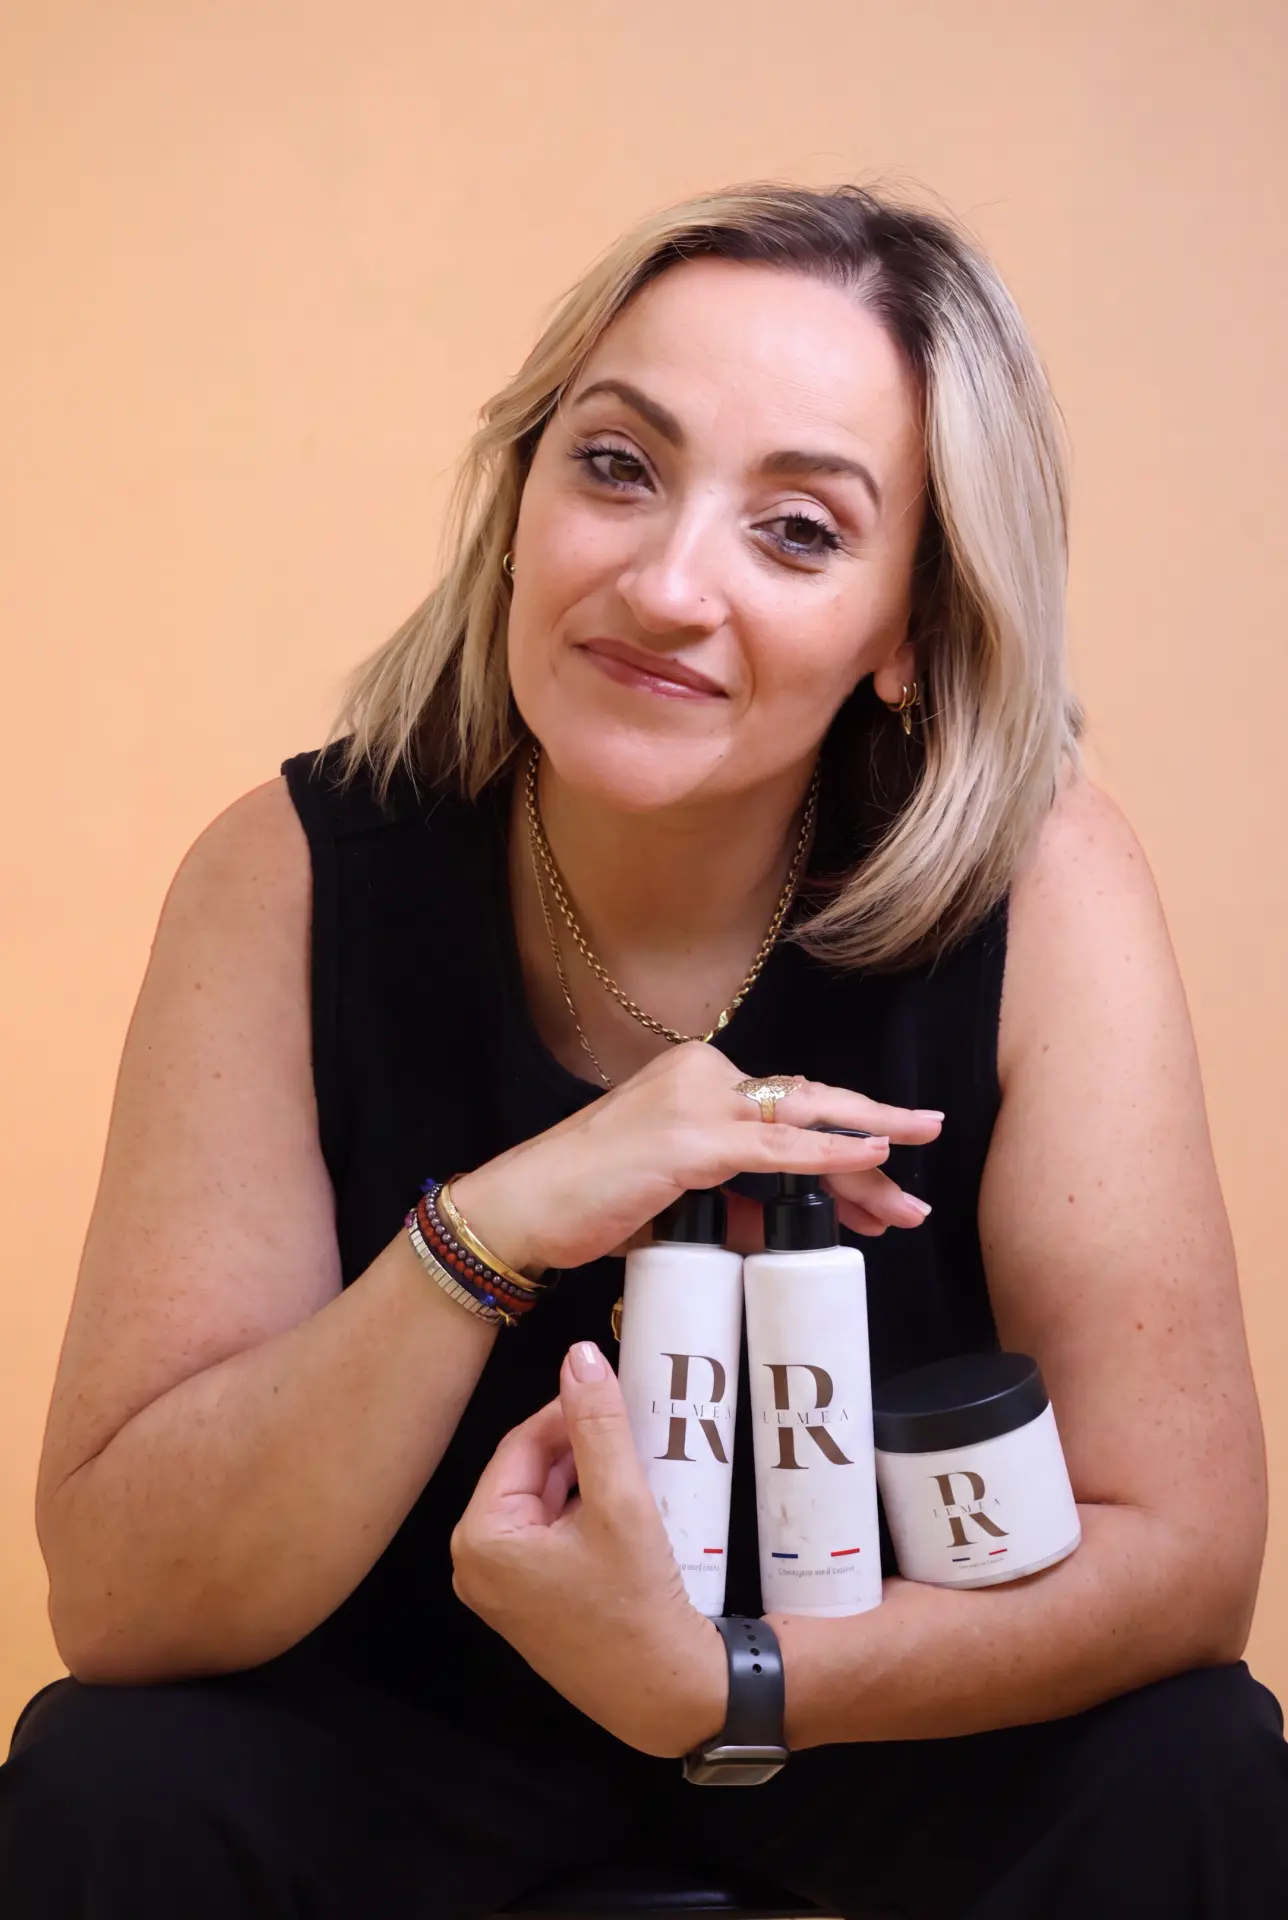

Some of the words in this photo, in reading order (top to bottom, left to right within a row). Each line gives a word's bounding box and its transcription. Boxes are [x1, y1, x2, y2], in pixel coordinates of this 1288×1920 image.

[653, 1352, 730, 1464] R
[762, 1364, 855, 1470] R
[926, 1471, 1010, 1548] R
